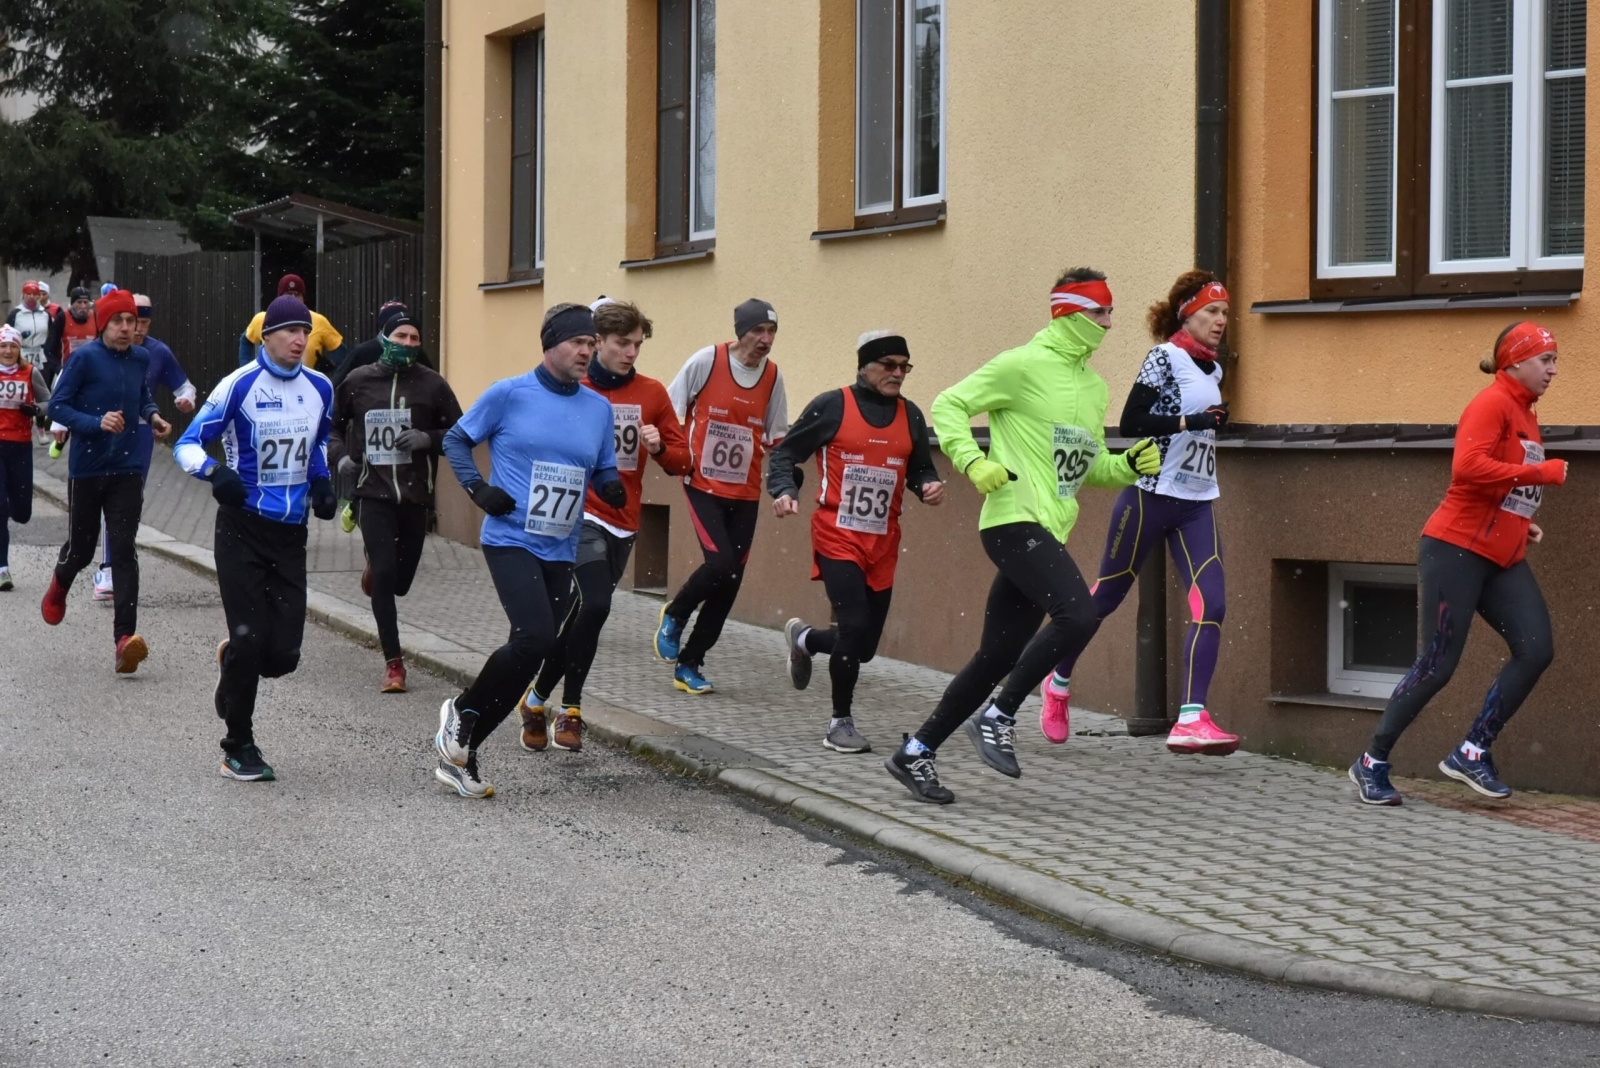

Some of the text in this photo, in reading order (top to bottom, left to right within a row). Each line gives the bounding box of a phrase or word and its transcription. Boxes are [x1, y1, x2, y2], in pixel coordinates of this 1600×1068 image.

[259, 419, 281, 429] ZIMNÍ
[259, 425, 310, 436] BĚŽECKÁ LIGA
[709, 422, 729, 432] ZIMNÍ
[368, 425, 402, 451] 40
[708, 429, 736, 440] BĚŽECKÁ
[738, 434, 752, 443] LIGA
[1054, 427, 1076, 436] ZIMNÍ
[261, 437, 307, 470] 274
[712, 440, 744, 469] 66
[1179, 439, 1215, 477] 276
[534, 463, 559, 474] ZIMNÍ
[846, 465, 869, 475] ZIMNÍ
[1053, 448, 1096, 482] 295
[533, 472, 583, 486] BĚŽECKÁ LIGA
[845, 473, 895, 487] BĚŽECKÁ LIGA
[529, 484, 581, 521] 277
[844, 485, 890, 519] 153
